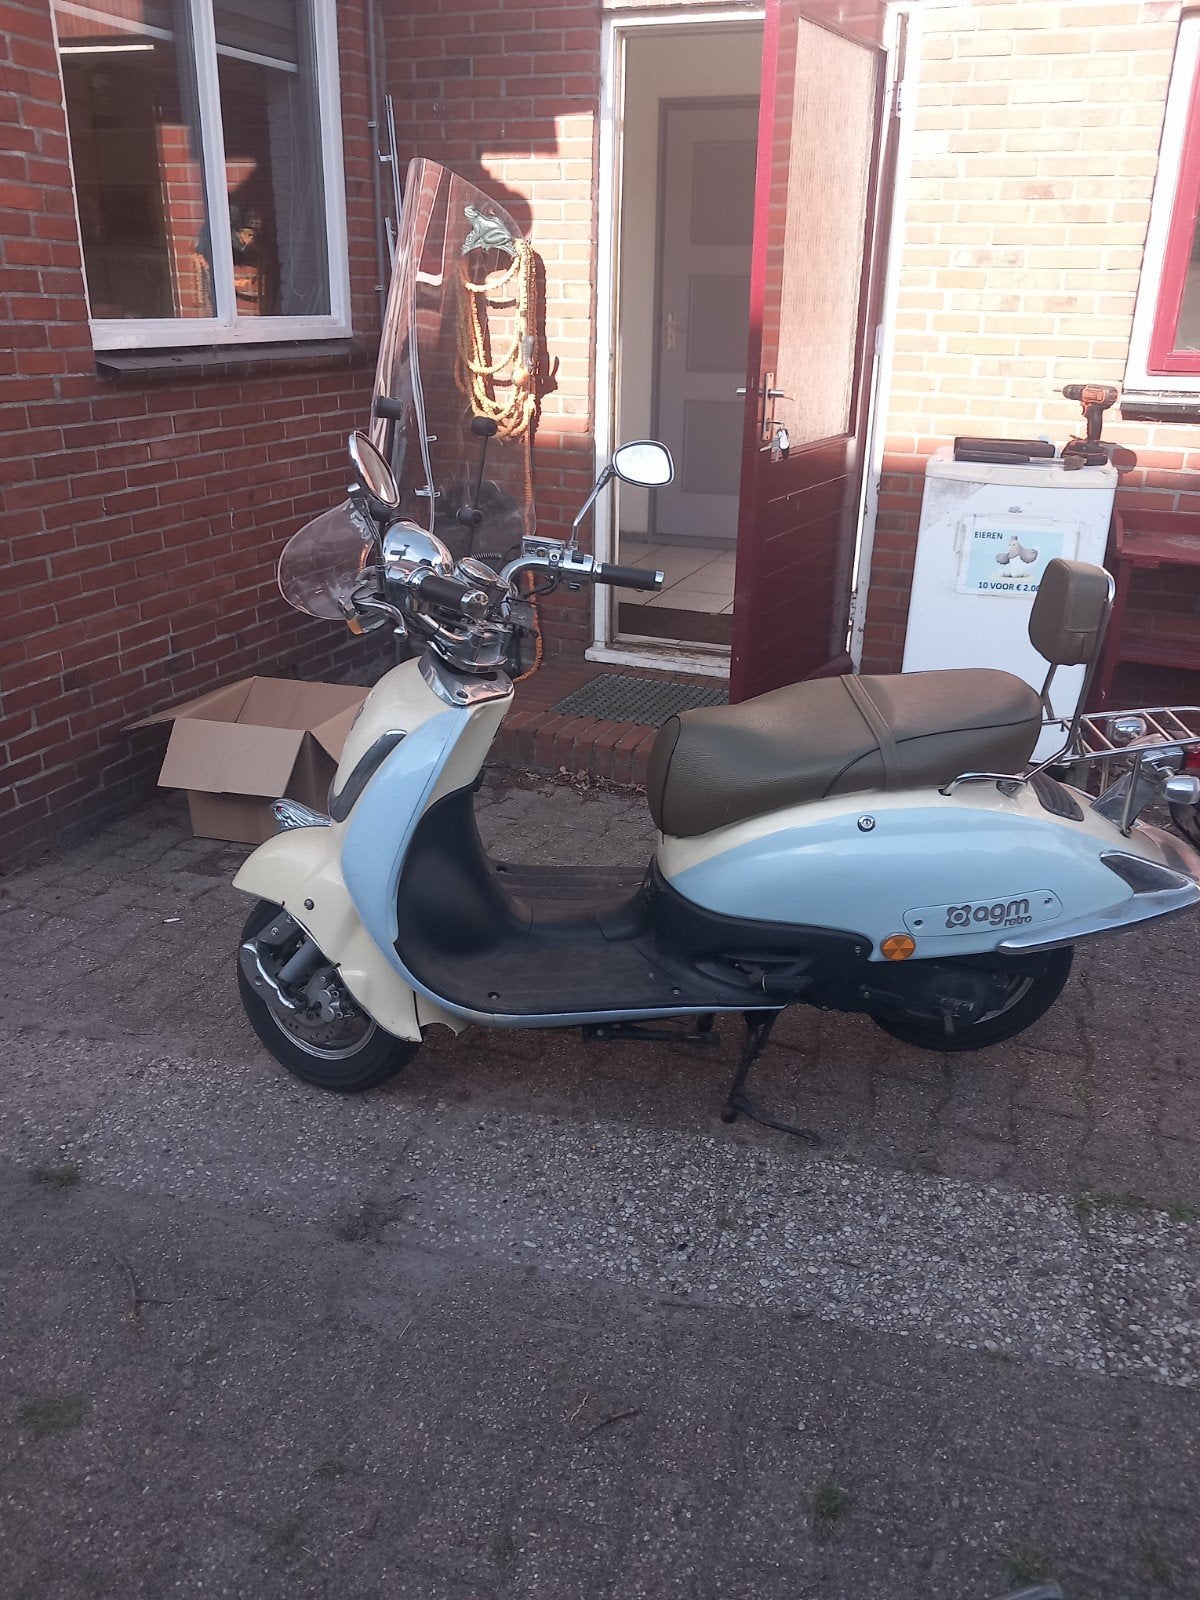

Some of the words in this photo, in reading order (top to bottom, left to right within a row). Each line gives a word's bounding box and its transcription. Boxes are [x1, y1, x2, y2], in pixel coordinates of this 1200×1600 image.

[974, 531, 1003, 540] EIEREN
[978, 581, 988, 589] 10
[990, 582, 1014, 590] VOOR
[973, 899, 1030, 925] agm
[1004, 915, 1032, 926] retro
